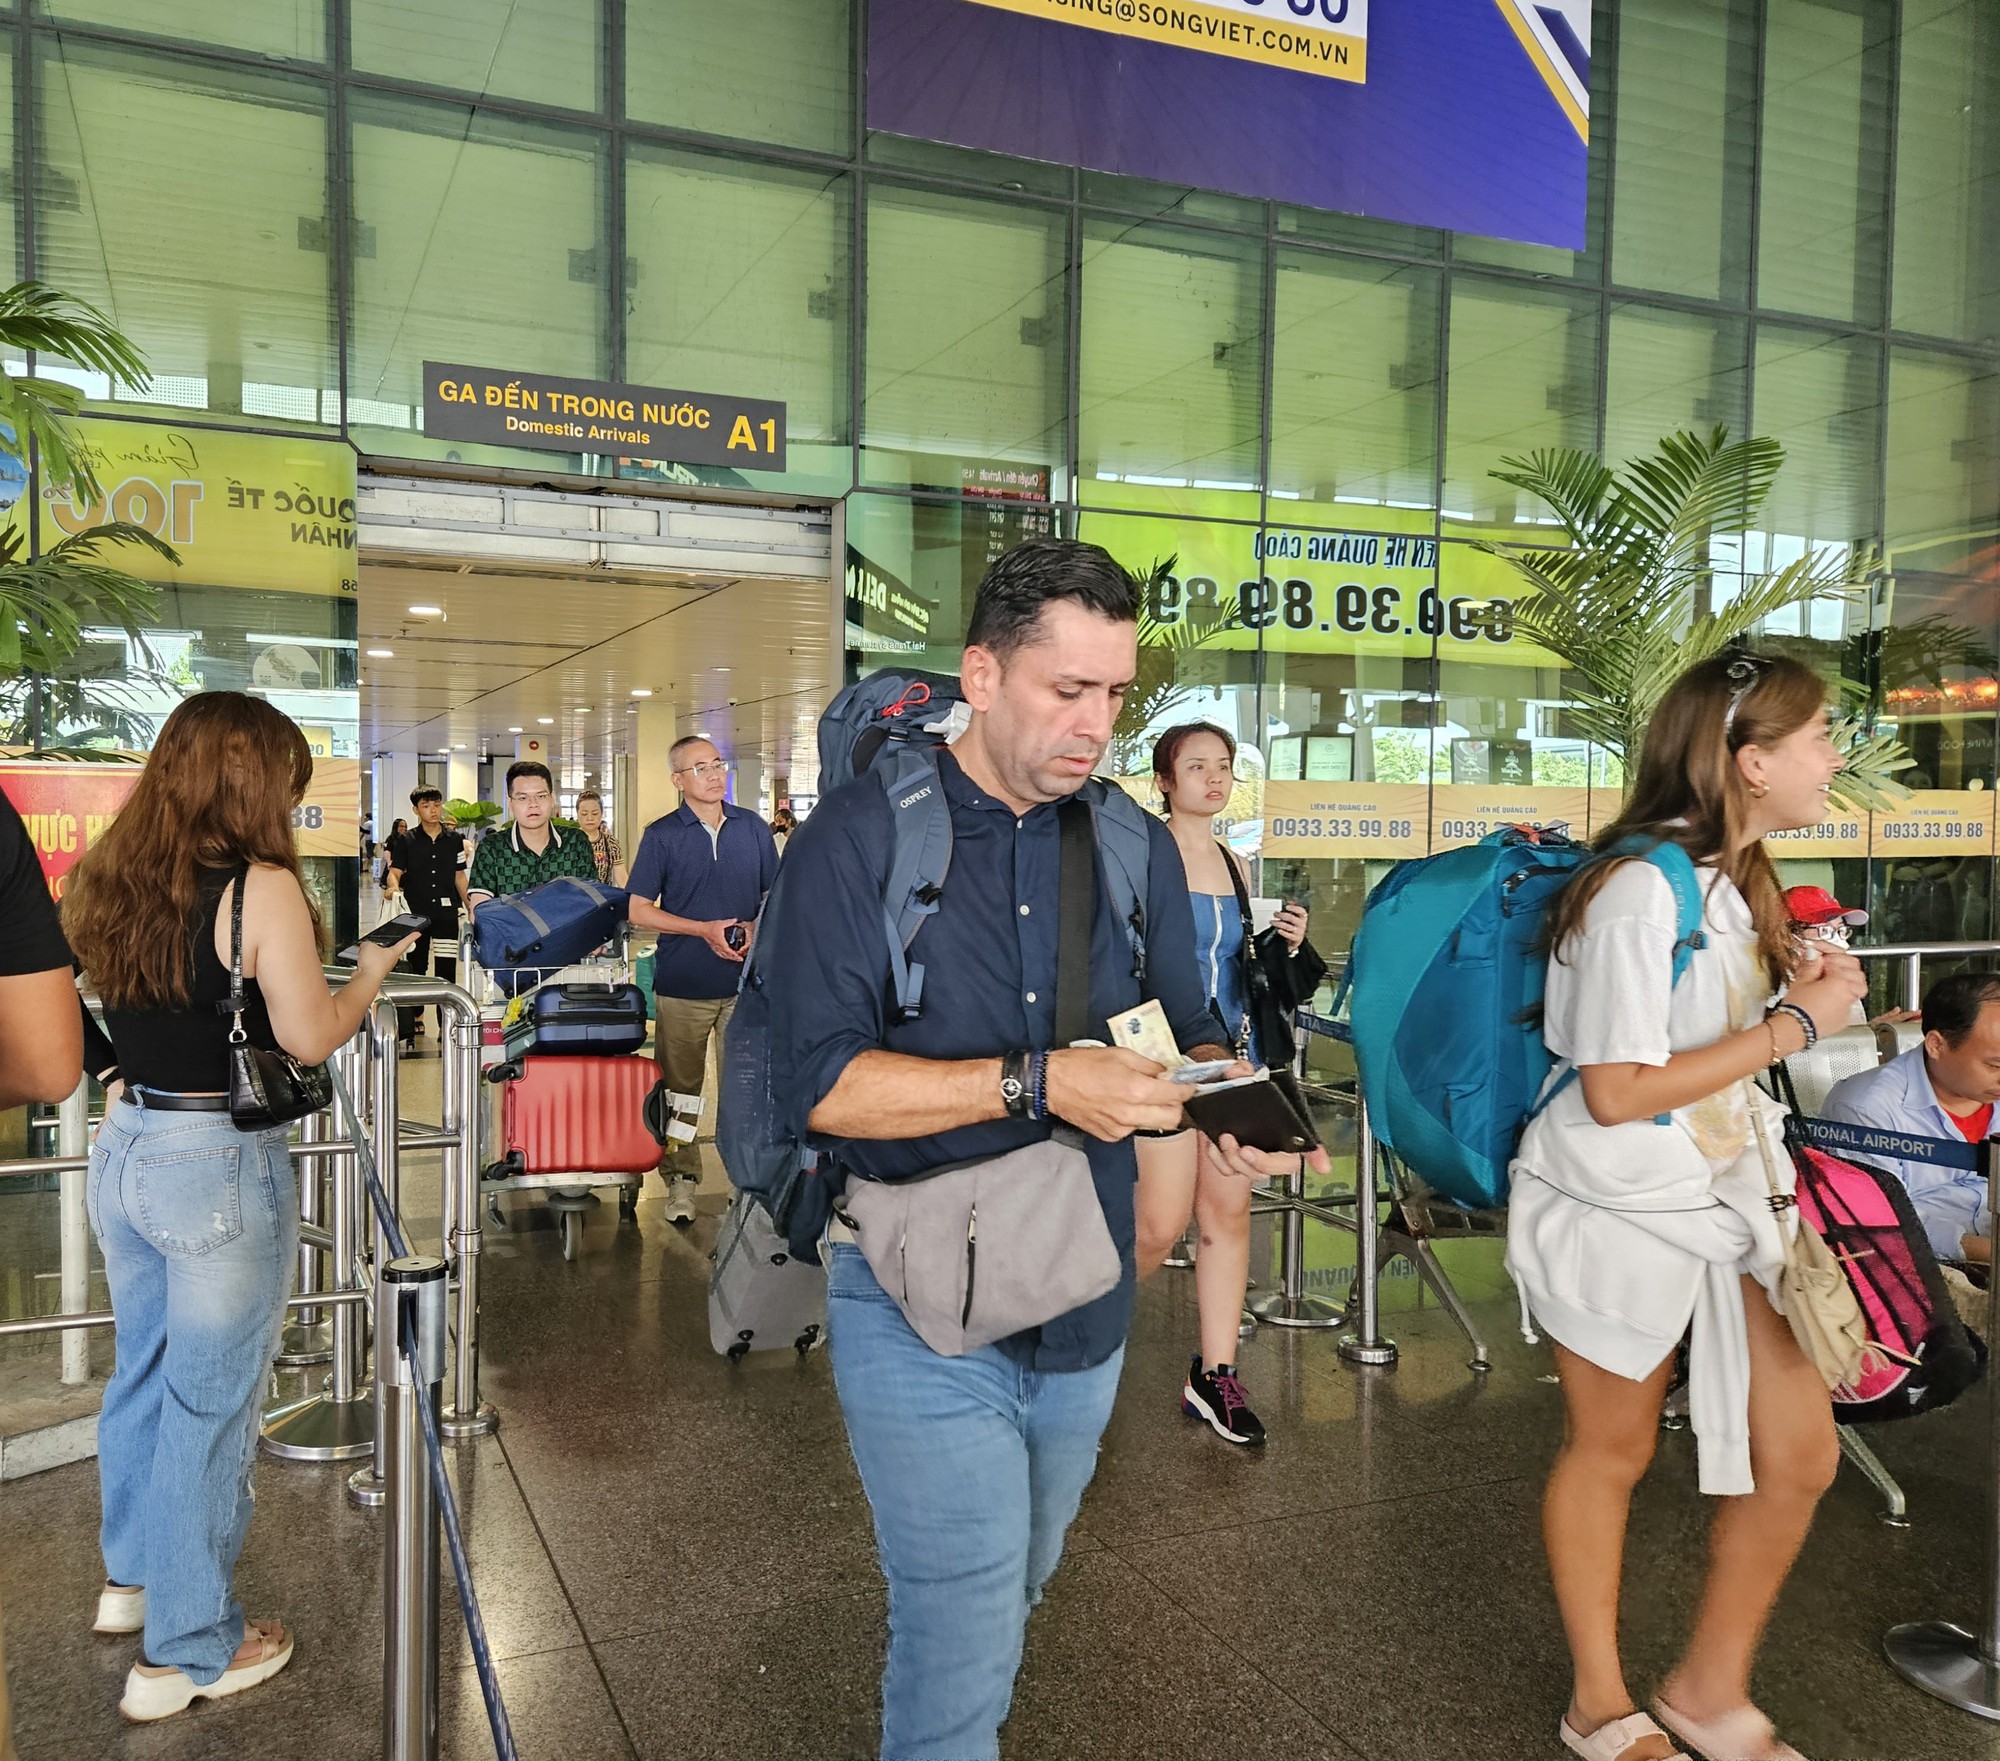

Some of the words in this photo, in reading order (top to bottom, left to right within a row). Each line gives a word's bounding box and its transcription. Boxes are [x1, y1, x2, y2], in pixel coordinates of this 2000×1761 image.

[439, 380, 477, 405] GA
[485, 380, 538, 411] ĐẾN
[547, 392, 634, 421] TRONG
[643, 402, 711, 429] NƯỚC
[727, 415, 775, 453] A1
[506, 416, 584, 439] Domestic
[588, 425, 651, 444] Arrivals
[900, 786, 932, 808] OSPREY
[1310, 803, 1326, 811] LIÊN
[1328, 802, 1337, 812] HỆ
[1338, 802, 1361, 812] QUẢNG
[1476, 805, 1491, 814] LIÊN
[1492, 805, 1501, 815] HỆ
[1502, 805, 1523, 815] QUẢNG
[1272, 818, 1411, 838] 0933.33.99.88
[1884, 822, 1983, 839] 0933.33.99.88
[1863, 1133, 1935, 1157] AIRPORT
